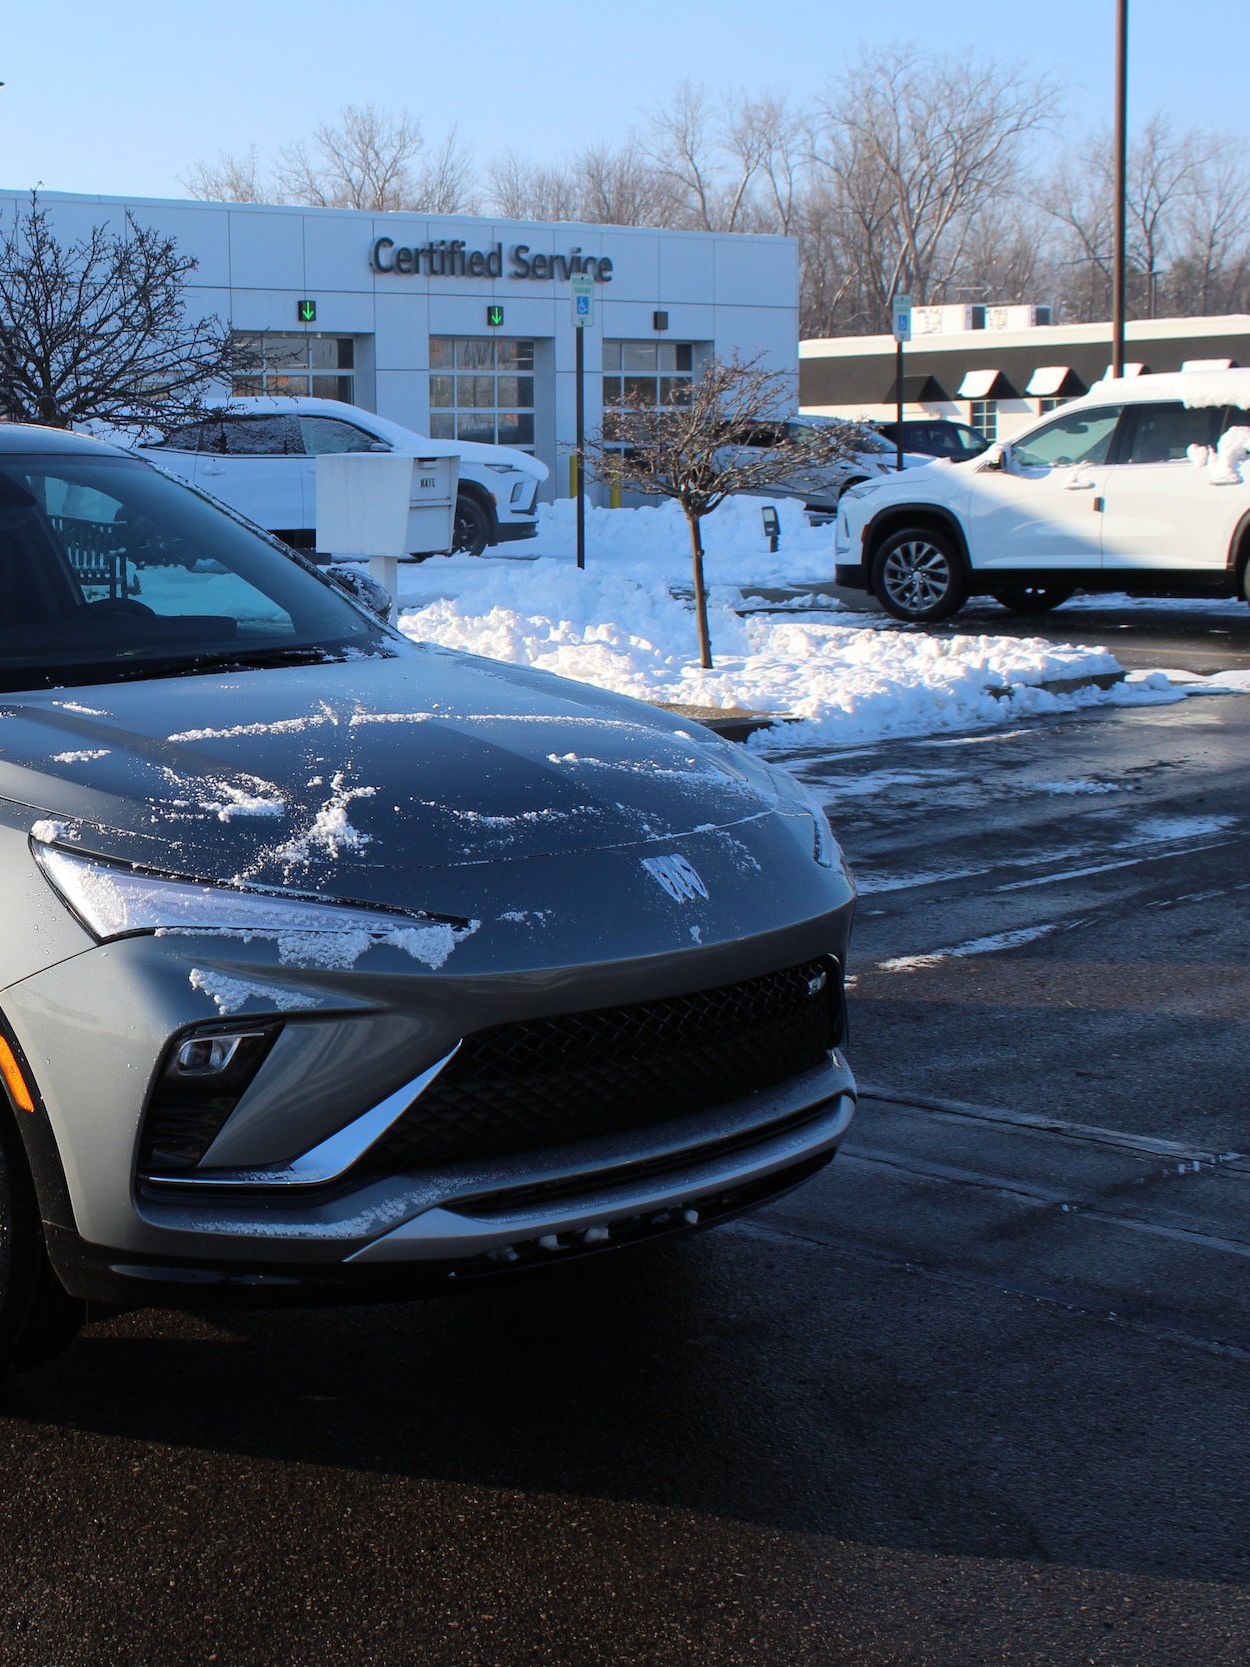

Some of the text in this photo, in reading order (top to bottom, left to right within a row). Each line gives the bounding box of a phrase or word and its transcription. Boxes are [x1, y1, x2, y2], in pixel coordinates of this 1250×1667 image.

[373, 237, 613, 282] Certified Service
[420, 477, 436, 489] MAIL
